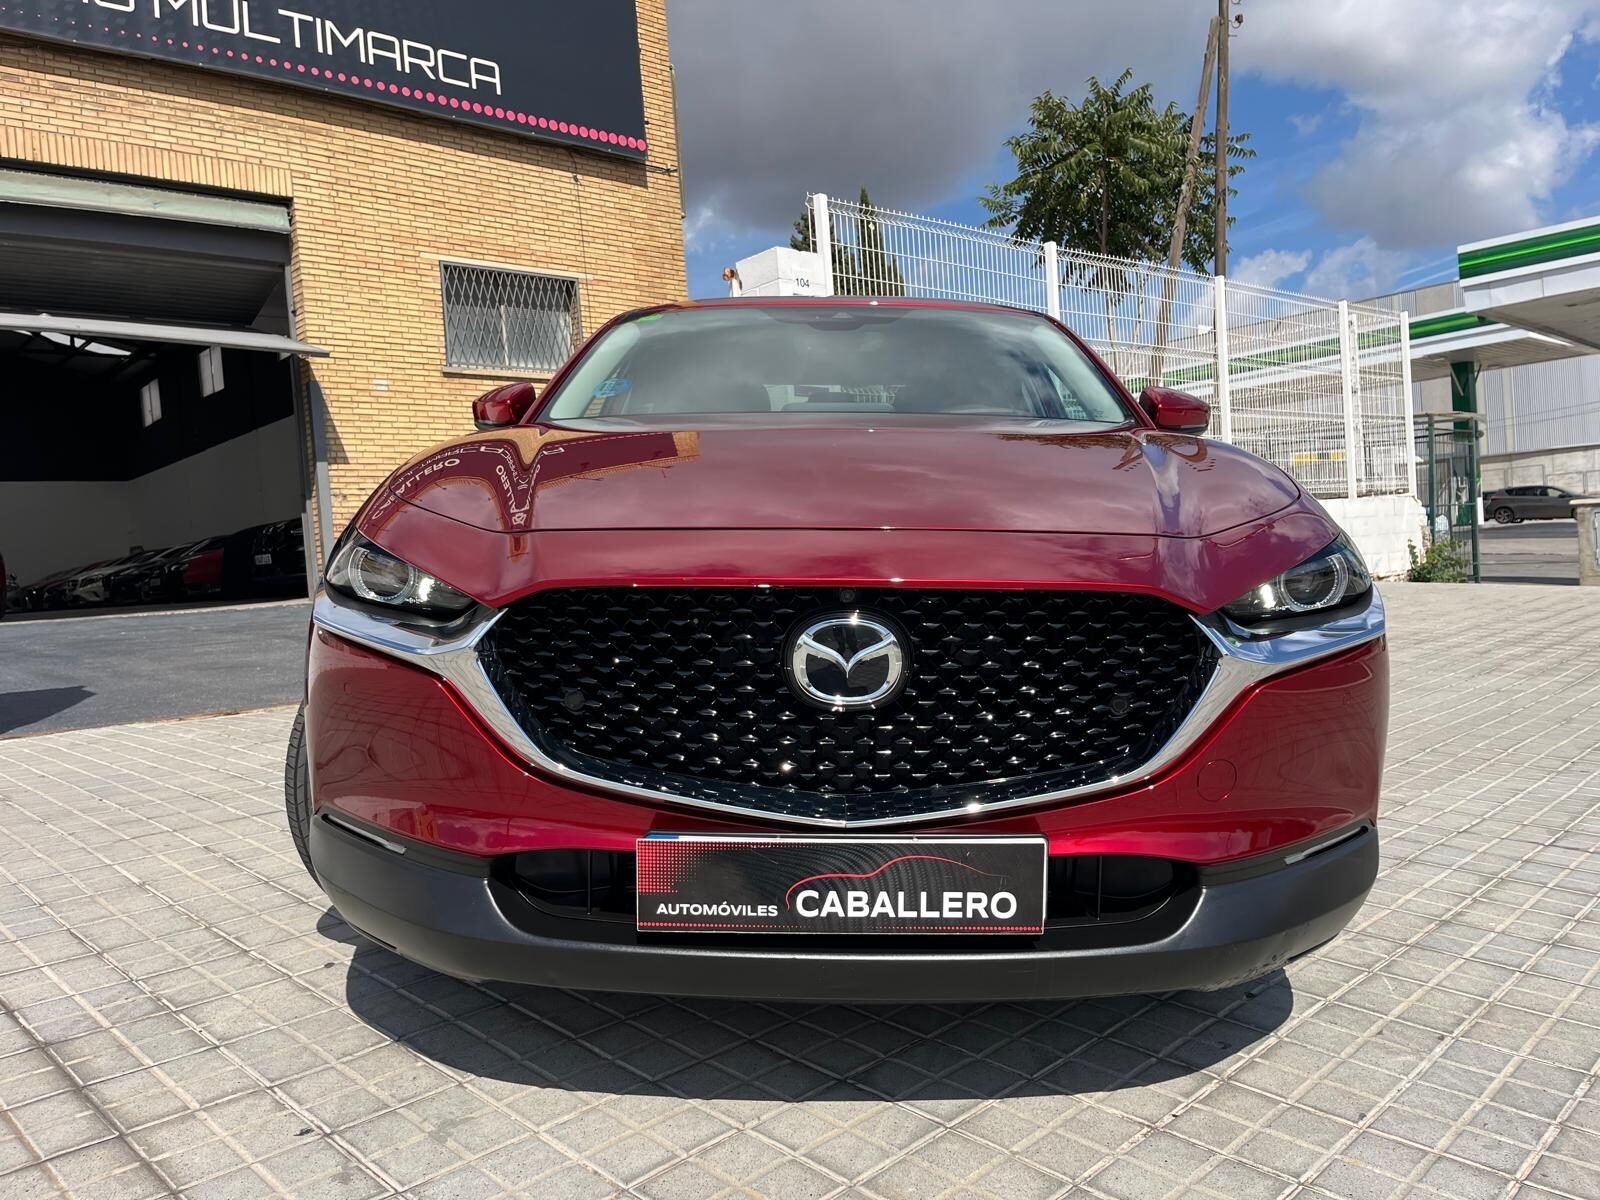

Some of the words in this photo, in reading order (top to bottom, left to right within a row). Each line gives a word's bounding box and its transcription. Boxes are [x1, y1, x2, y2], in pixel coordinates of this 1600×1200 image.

[795, 278, 810, 288] 104
[656, 901, 778, 917] AUTOMÓVILES
[795, 890, 1017, 919] CABALLERO
